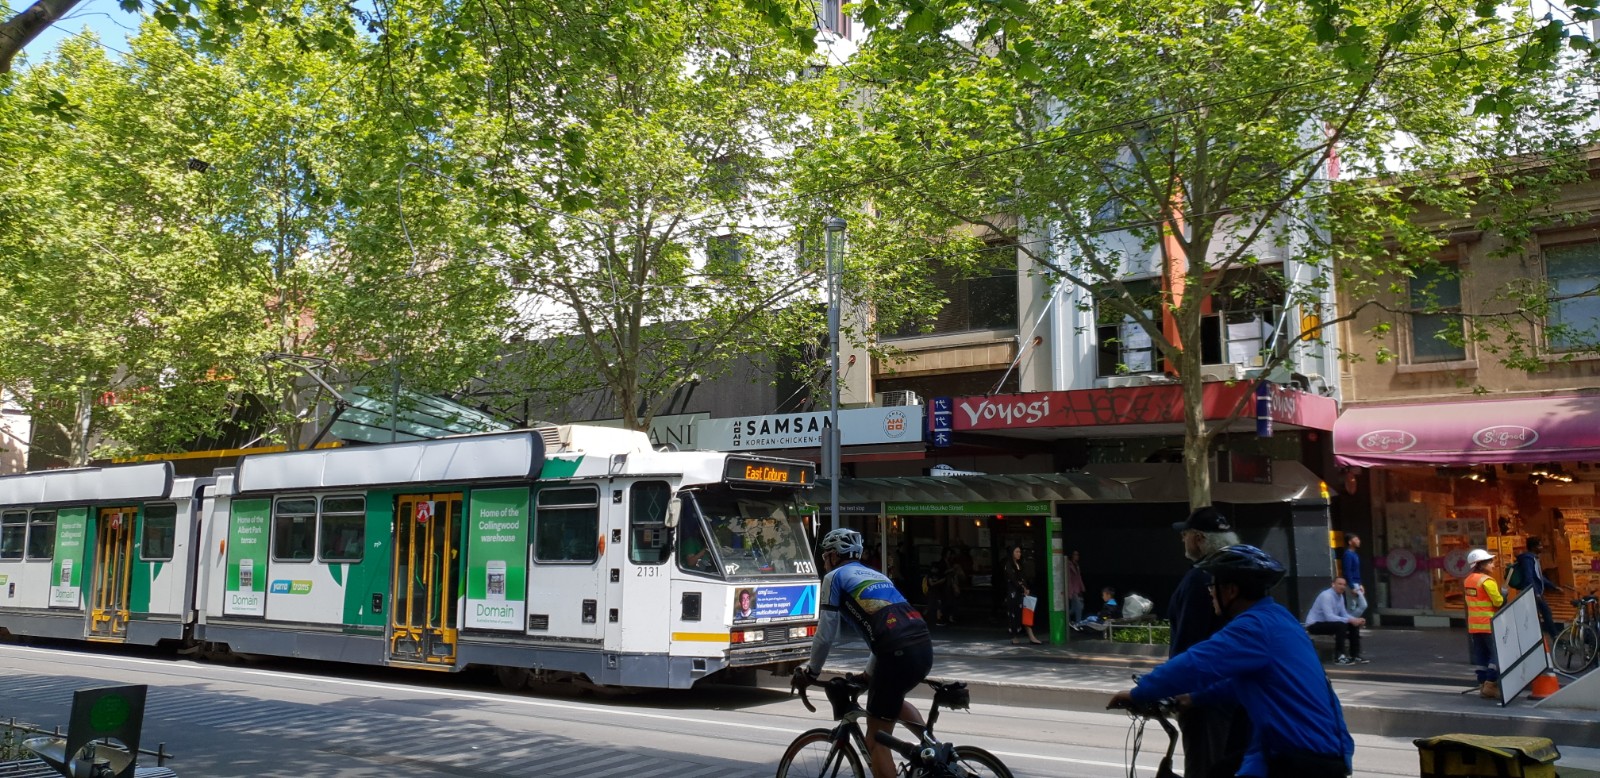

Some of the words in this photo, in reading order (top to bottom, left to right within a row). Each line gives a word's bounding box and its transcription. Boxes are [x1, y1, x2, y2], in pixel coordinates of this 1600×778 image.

[960, 396, 1050, 427] Yoyogi
[935, 399, 948, 445] 代代木
[745, 465, 762, 480] East
[763, 467, 788, 482] Coburg
[800, 470, 805, 484] 1
[480, 509, 499, 517] Home
[500, 508, 508, 517] of
[508, 508, 519, 517] the
[1026, 504, 1040, 512] Stop
[479, 521, 519, 531] Collingwood
[481, 533, 516, 542] warehouse
[637, 566, 660, 577] 2131
[794, 561, 814, 574] 2131
[273, 583, 288, 592] yarra
[55, 589, 75, 598] Domain
[232, 595, 258, 606] Domain
[476, 604, 515, 618] Domain
